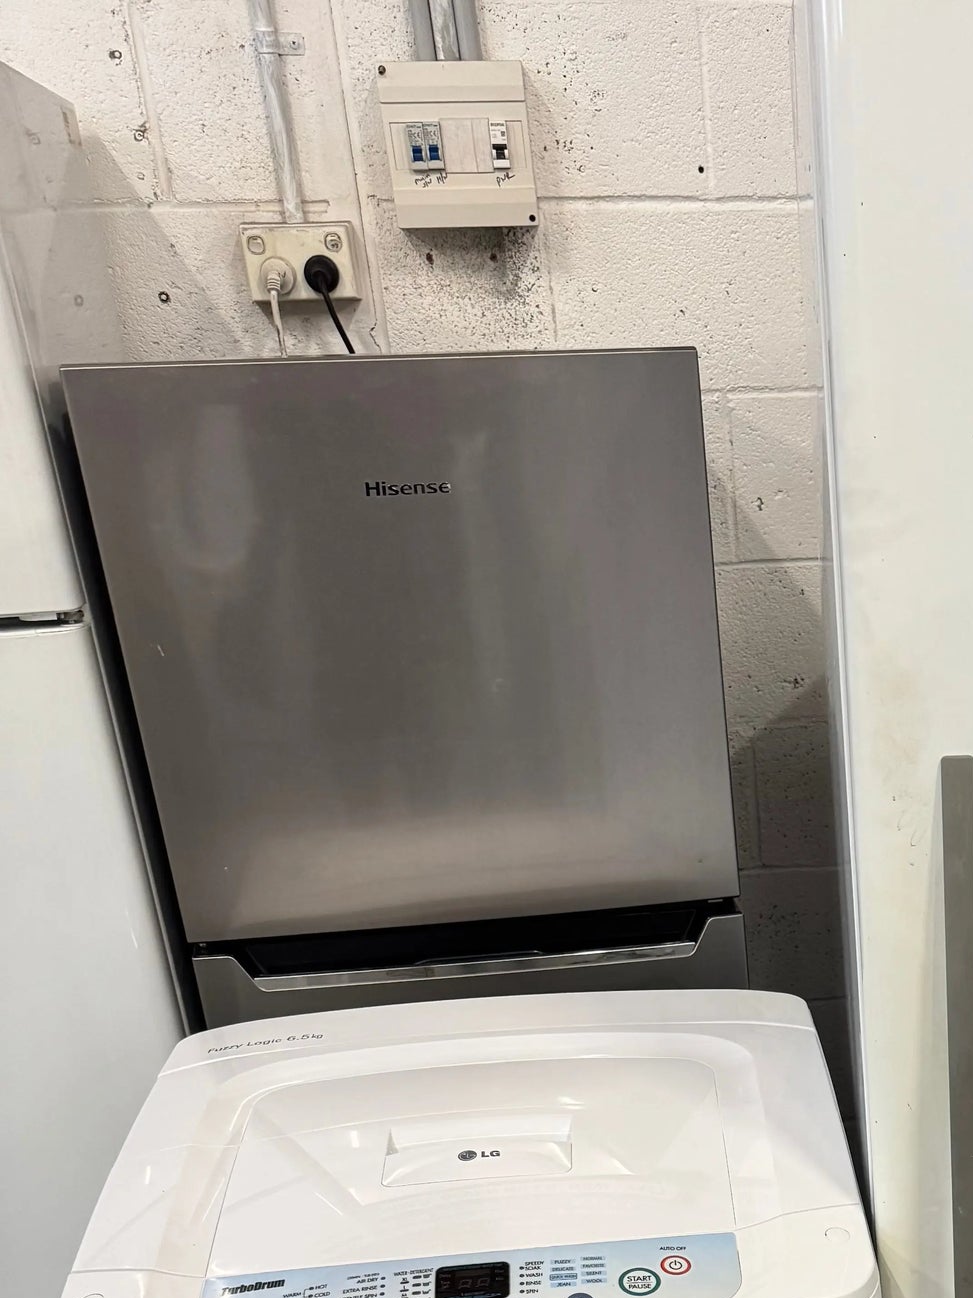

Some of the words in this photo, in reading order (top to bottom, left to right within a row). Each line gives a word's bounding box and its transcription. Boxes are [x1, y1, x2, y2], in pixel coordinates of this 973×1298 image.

[364, 481, 451, 497] Hisense
[207, 1043, 243, 1054] Fuzzy
[246, 1038, 282, 1047] Logic
[481, 1150, 501, 1158] LG
[221, 1279, 286, 1297] TurboDrum
